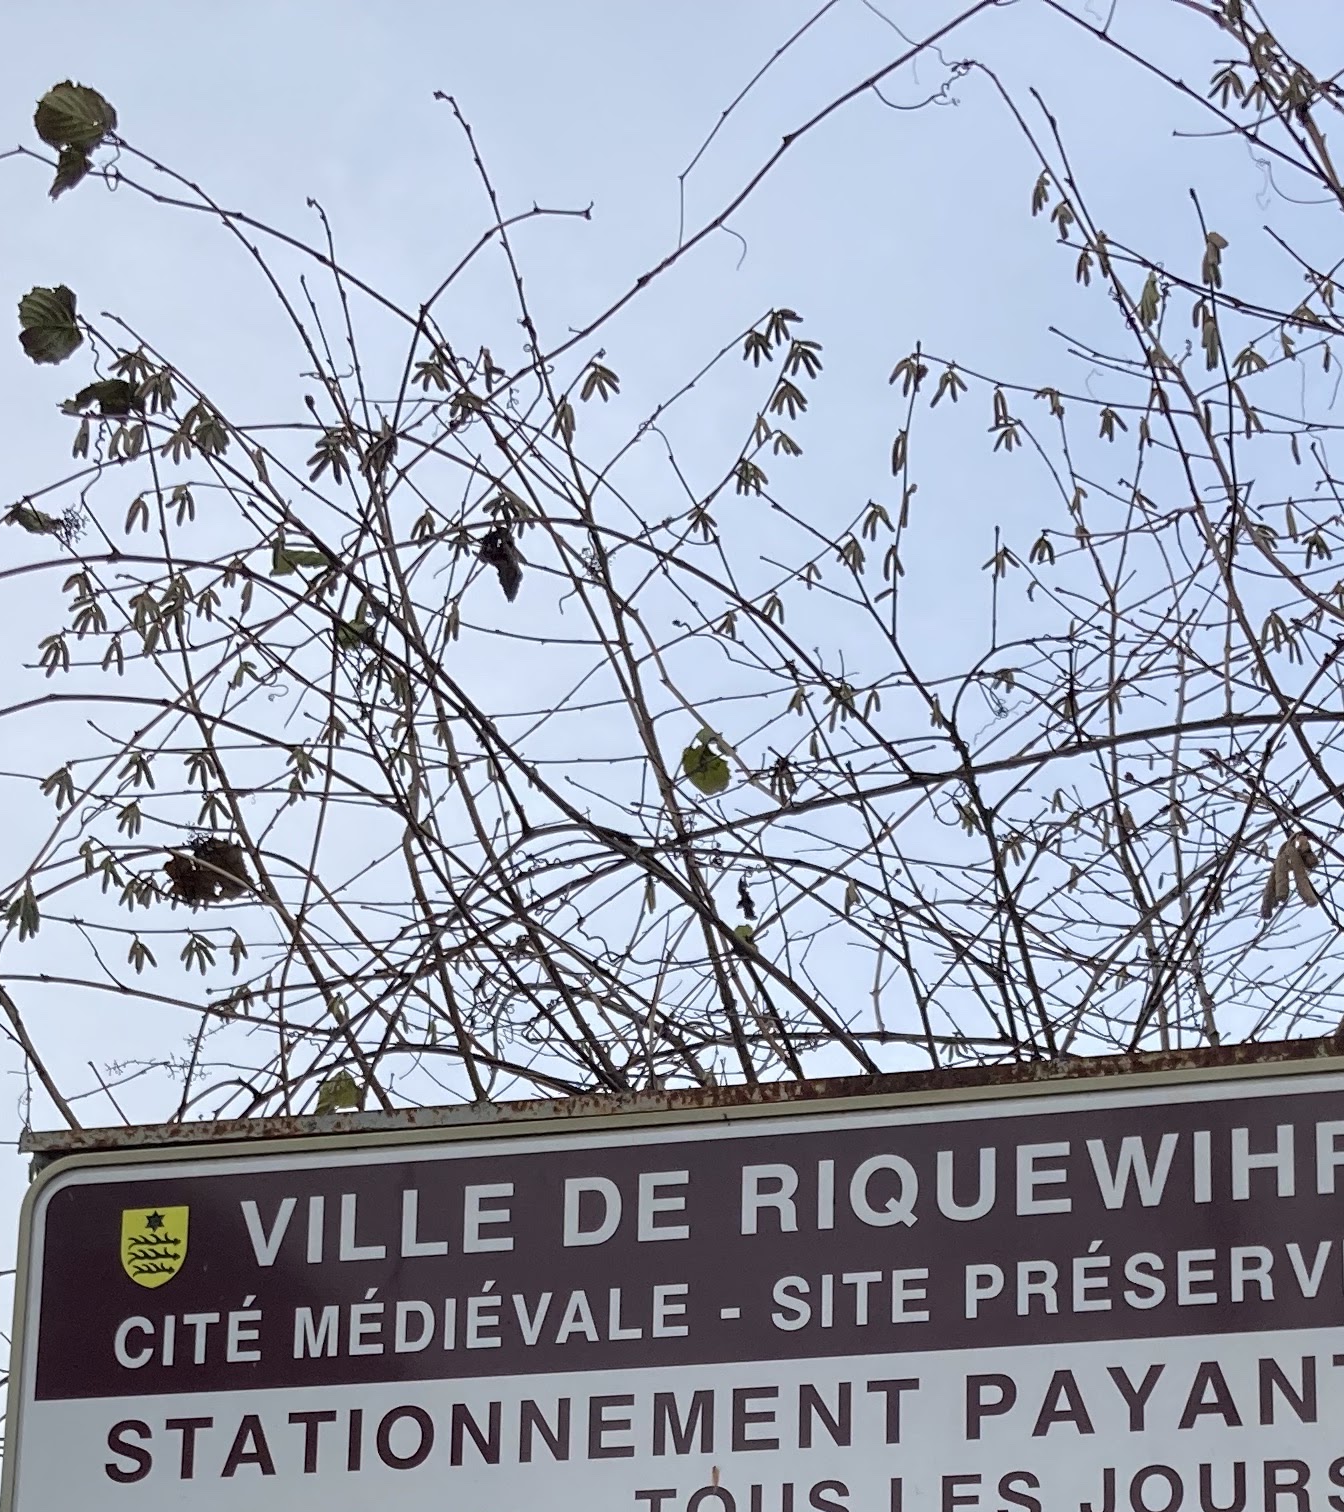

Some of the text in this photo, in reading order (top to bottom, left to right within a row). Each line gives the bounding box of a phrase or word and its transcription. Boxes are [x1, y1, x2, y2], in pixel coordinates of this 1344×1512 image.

[241, 1183, 513, 1266] VILLE
[564, 1170, 689, 1246] DE
[115, 1295, 261, 1368] CITÉ
[294, 1280, 688, 1358] MÉDIÉVALE
[772, 1268, 929, 1330] SITE
[105, 1378, 919, 1483] STATIONNEMENT
